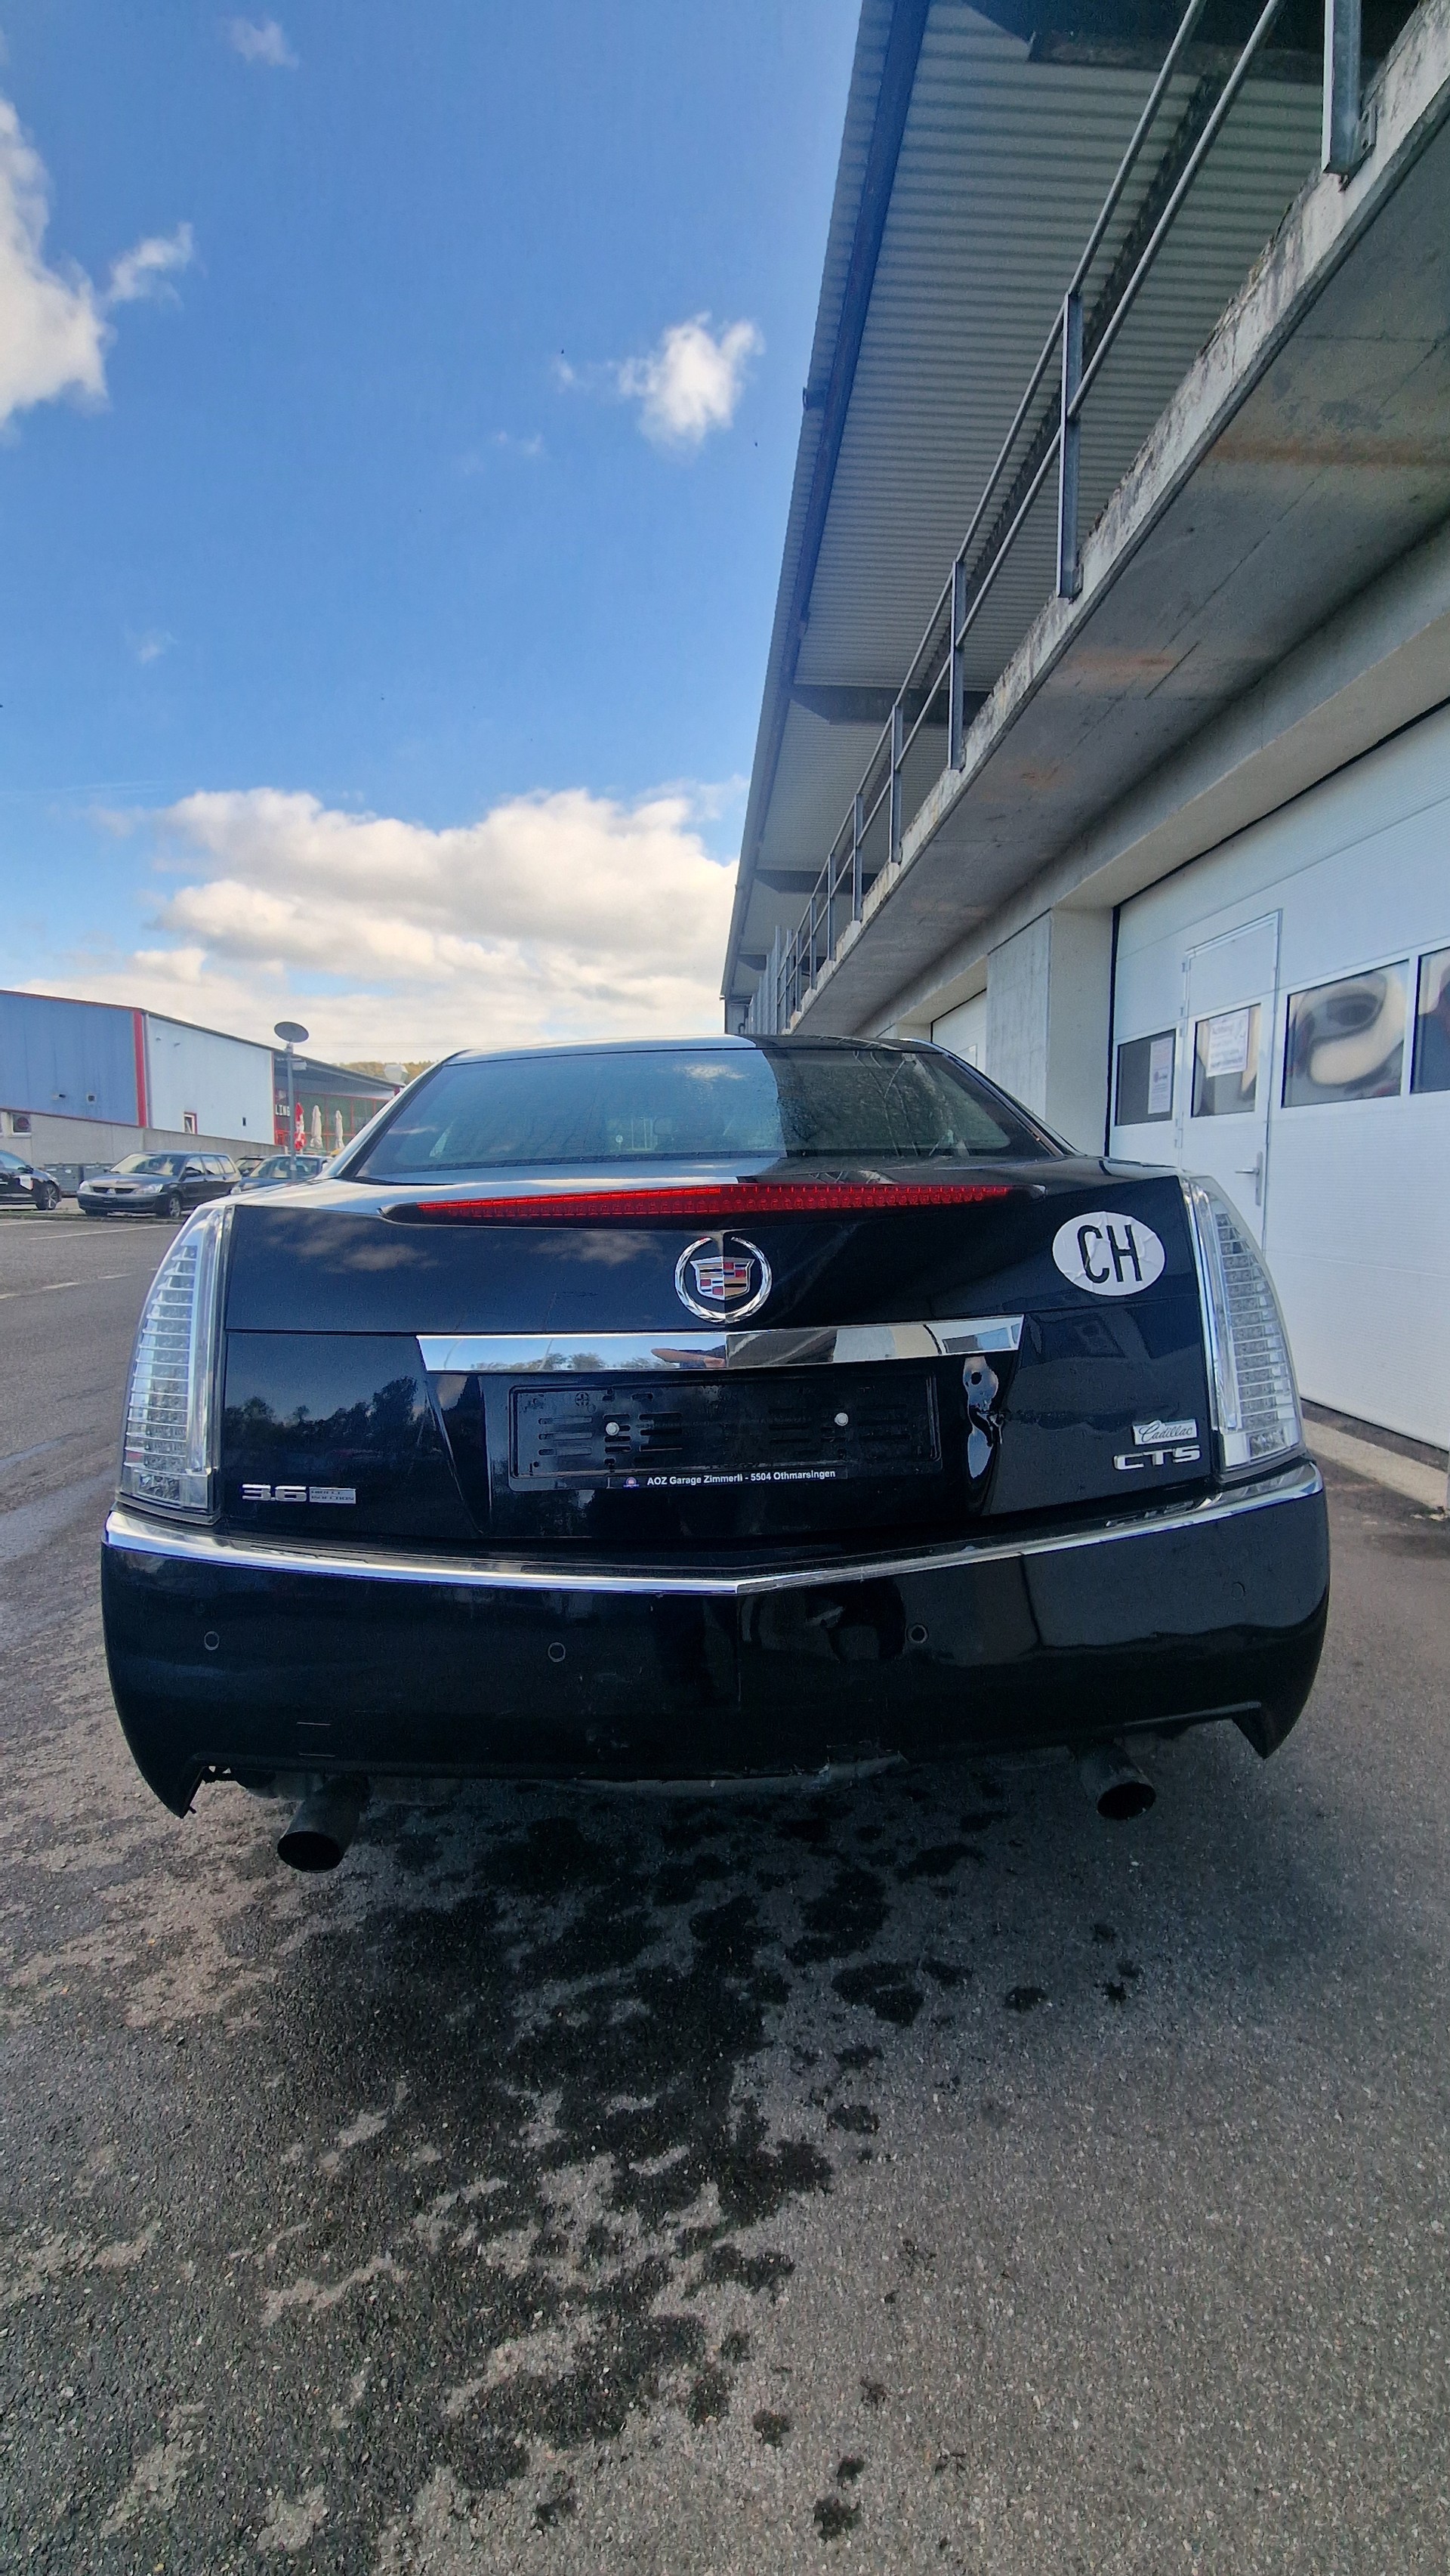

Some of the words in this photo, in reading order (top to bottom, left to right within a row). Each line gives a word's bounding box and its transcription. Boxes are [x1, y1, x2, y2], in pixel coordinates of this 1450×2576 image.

[1077, 1225, 1143, 1283] CH
[1138, 1422, 1193, 1443] Cadillac
[1113, 1444, 1201, 1470] CTS
[647, 1476, 668, 1485] AOZ
[669, 1476, 702, 1486] Garage
[704, 1474, 743, 1484] Zimmerli
[751, 1472, 772, 1481] 5504
[773, 1470, 836, 1481] Othmarsingen
[242, 1484, 307, 1502] 3.6
